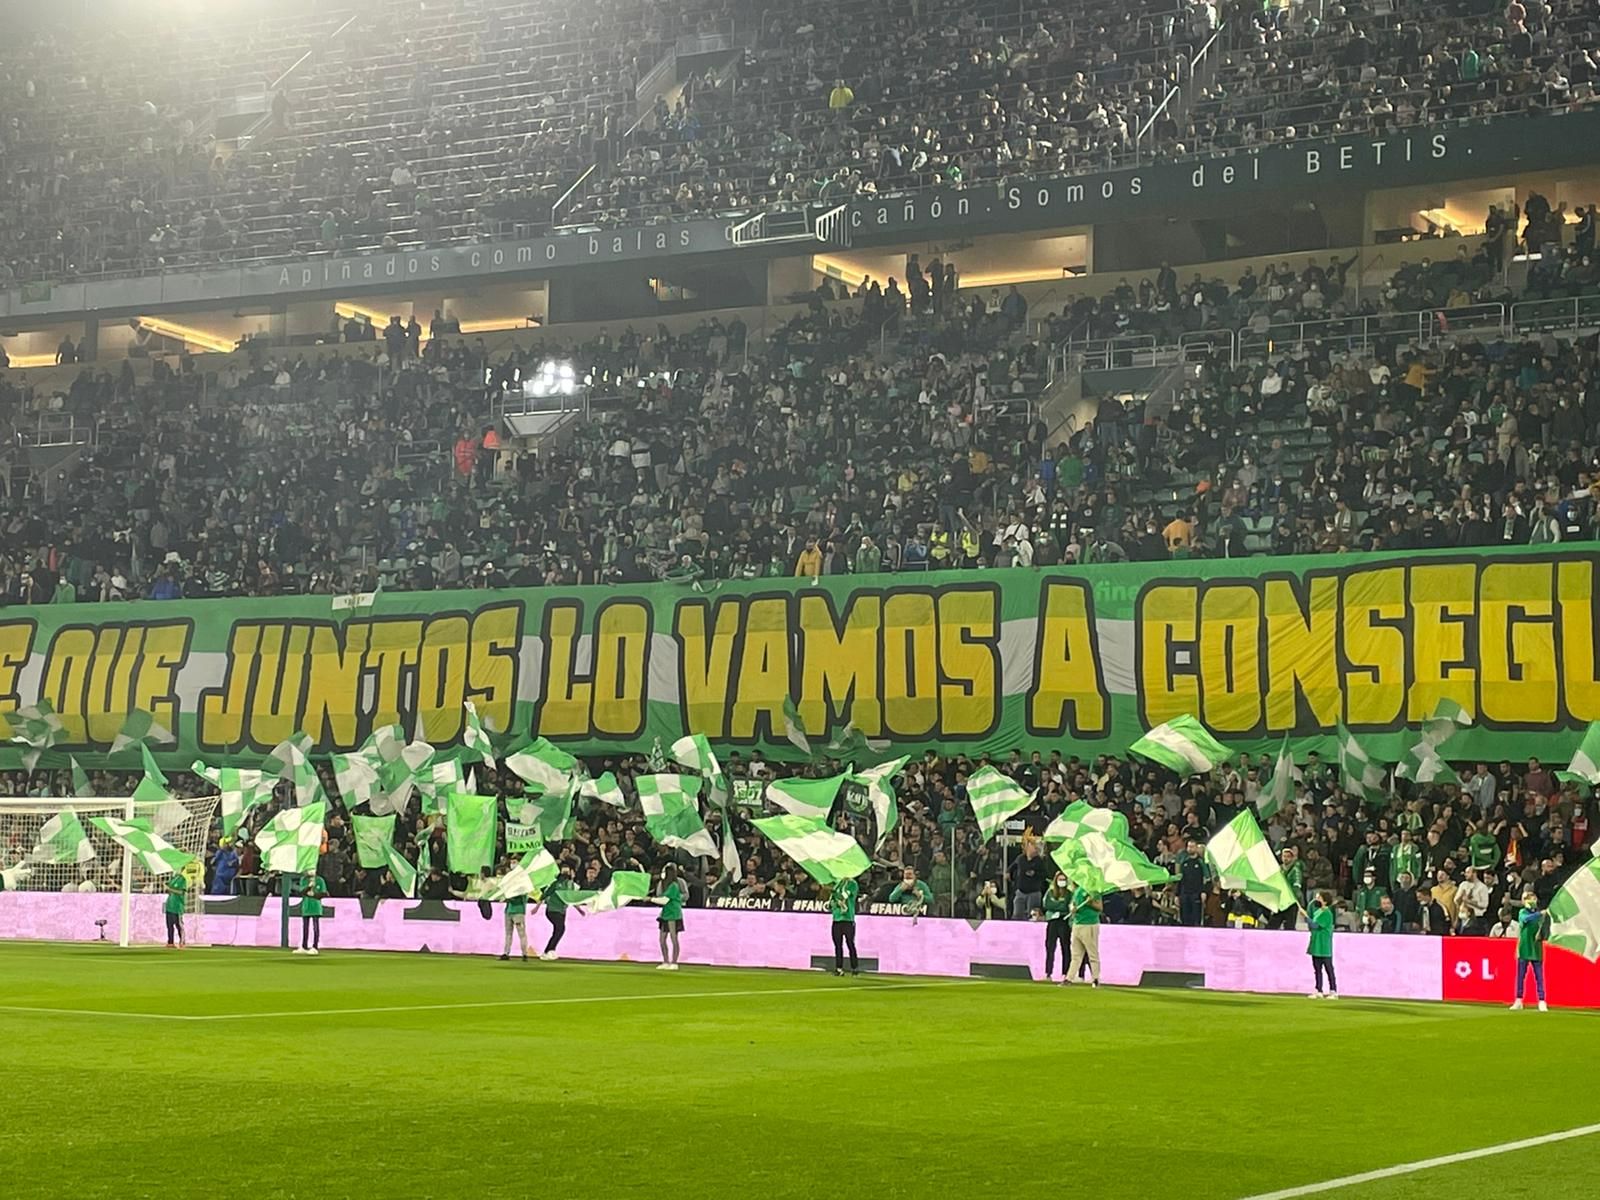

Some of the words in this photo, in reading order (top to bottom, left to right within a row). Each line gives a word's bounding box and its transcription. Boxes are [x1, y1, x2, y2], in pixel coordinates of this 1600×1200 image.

[279, 255, 440, 287] Apiñados
[471, 243, 556, 267] como
[589, 229, 690, 255] balas
[1008, 177, 1142, 209] Somos
[1192, 158, 1259, 187] del
[1307, 135, 1472, 173] BETIS.
[38, 618, 194, 750] QUE
[198, 600, 525, 752] JUNTOS
[533, 597, 654, 742] LO
[677, 582, 1001, 743] VAMOS
[1024, 576, 1110, 737] A
[717, 897, 771, 910] #FANCAM
[792, 899, 830, 913] #FANC
